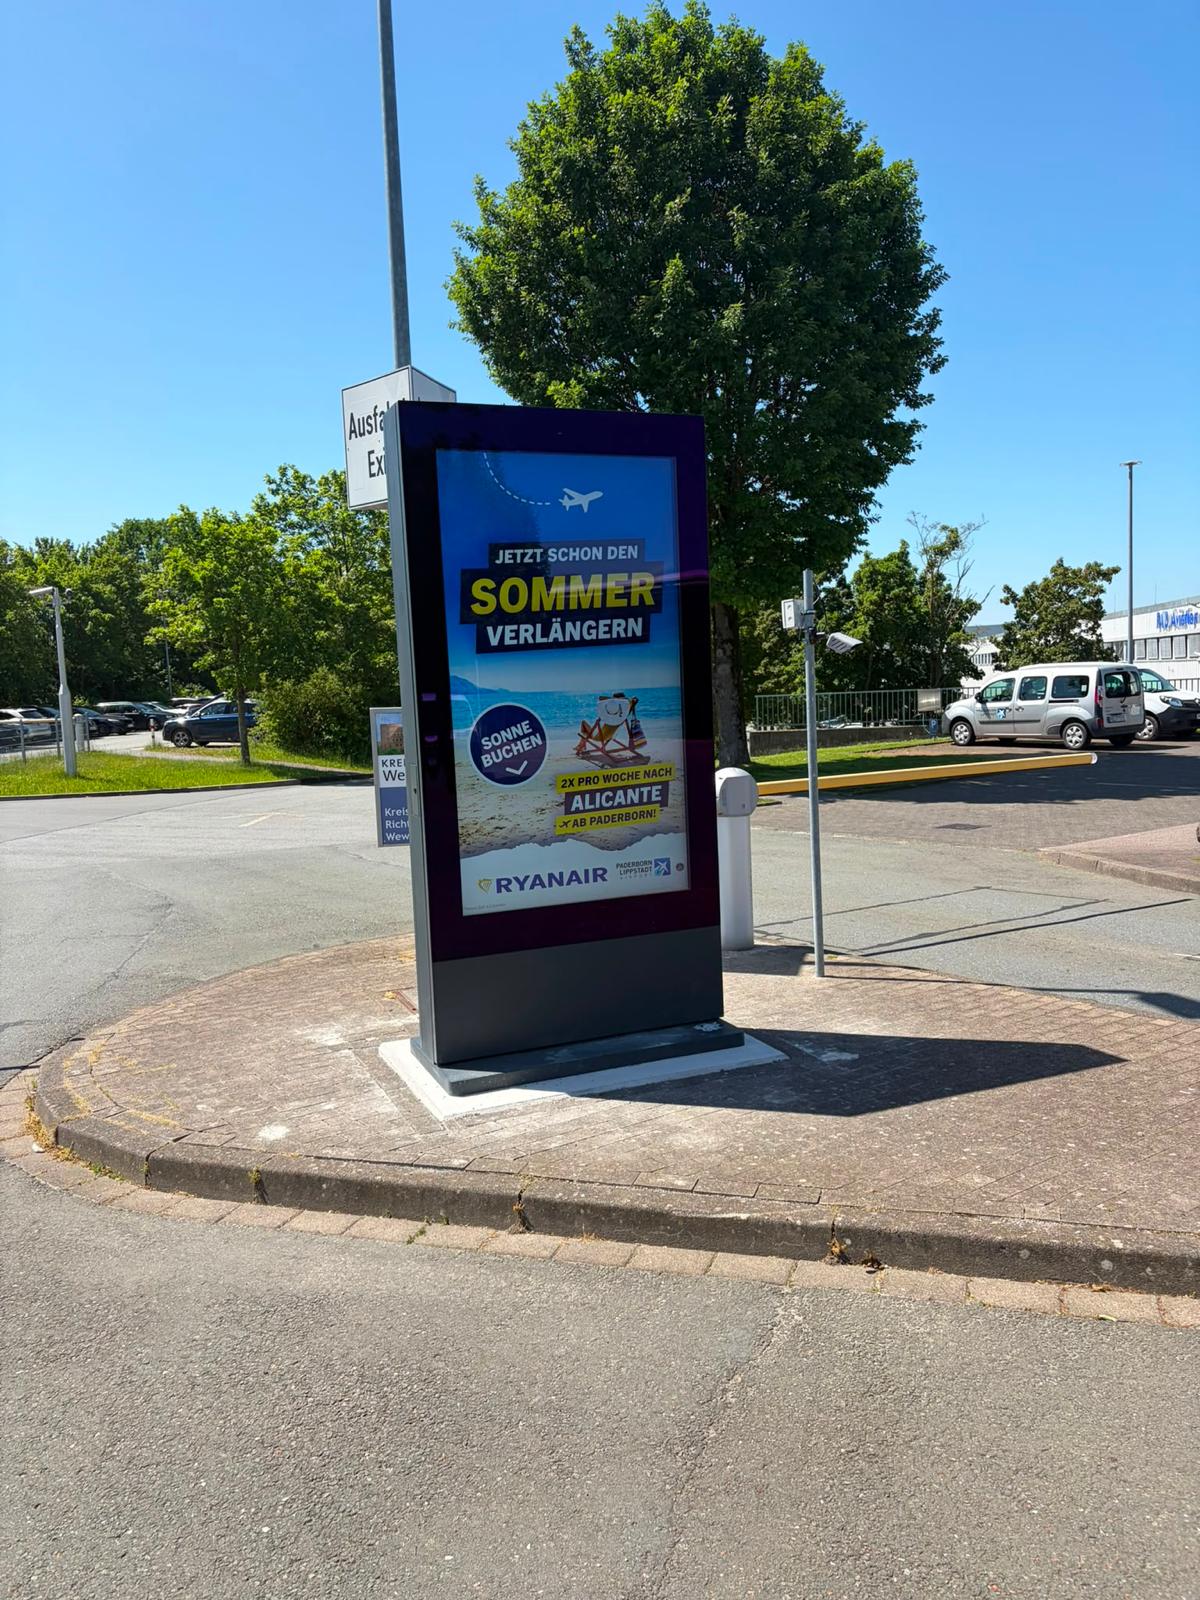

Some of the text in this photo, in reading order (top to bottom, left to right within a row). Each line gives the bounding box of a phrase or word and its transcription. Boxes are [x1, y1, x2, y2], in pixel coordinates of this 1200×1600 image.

[349, 401, 389, 440] Ausfa
[368, 448, 386, 478] Ex
[495, 545, 639, 564] JETZT SCHON DEN
[470, 572, 655, 615] SOMMER
[486, 617, 643, 646] VERLÄNGERN
[481, 720, 533, 750] SONNE
[481, 733, 543, 768] BUCHEN
[382, 758, 405, 768] KRE
[383, 769, 405, 781] We
[560, 767, 673, 788] 2X PRO WOCHE NACH
[570, 785, 662, 812] ALICANTE
[385, 807, 409, 817] Kreis
[572, 809, 657, 828] AB PADERBORN!
[386, 819, 409, 829] Rich
[386, 832, 410, 841] Wew
[616, 860, 652, 869] PADERBORN
[620, 866, 652, 876] LIPPSTADT
[496, 867, 609, 894] RYANAIR
